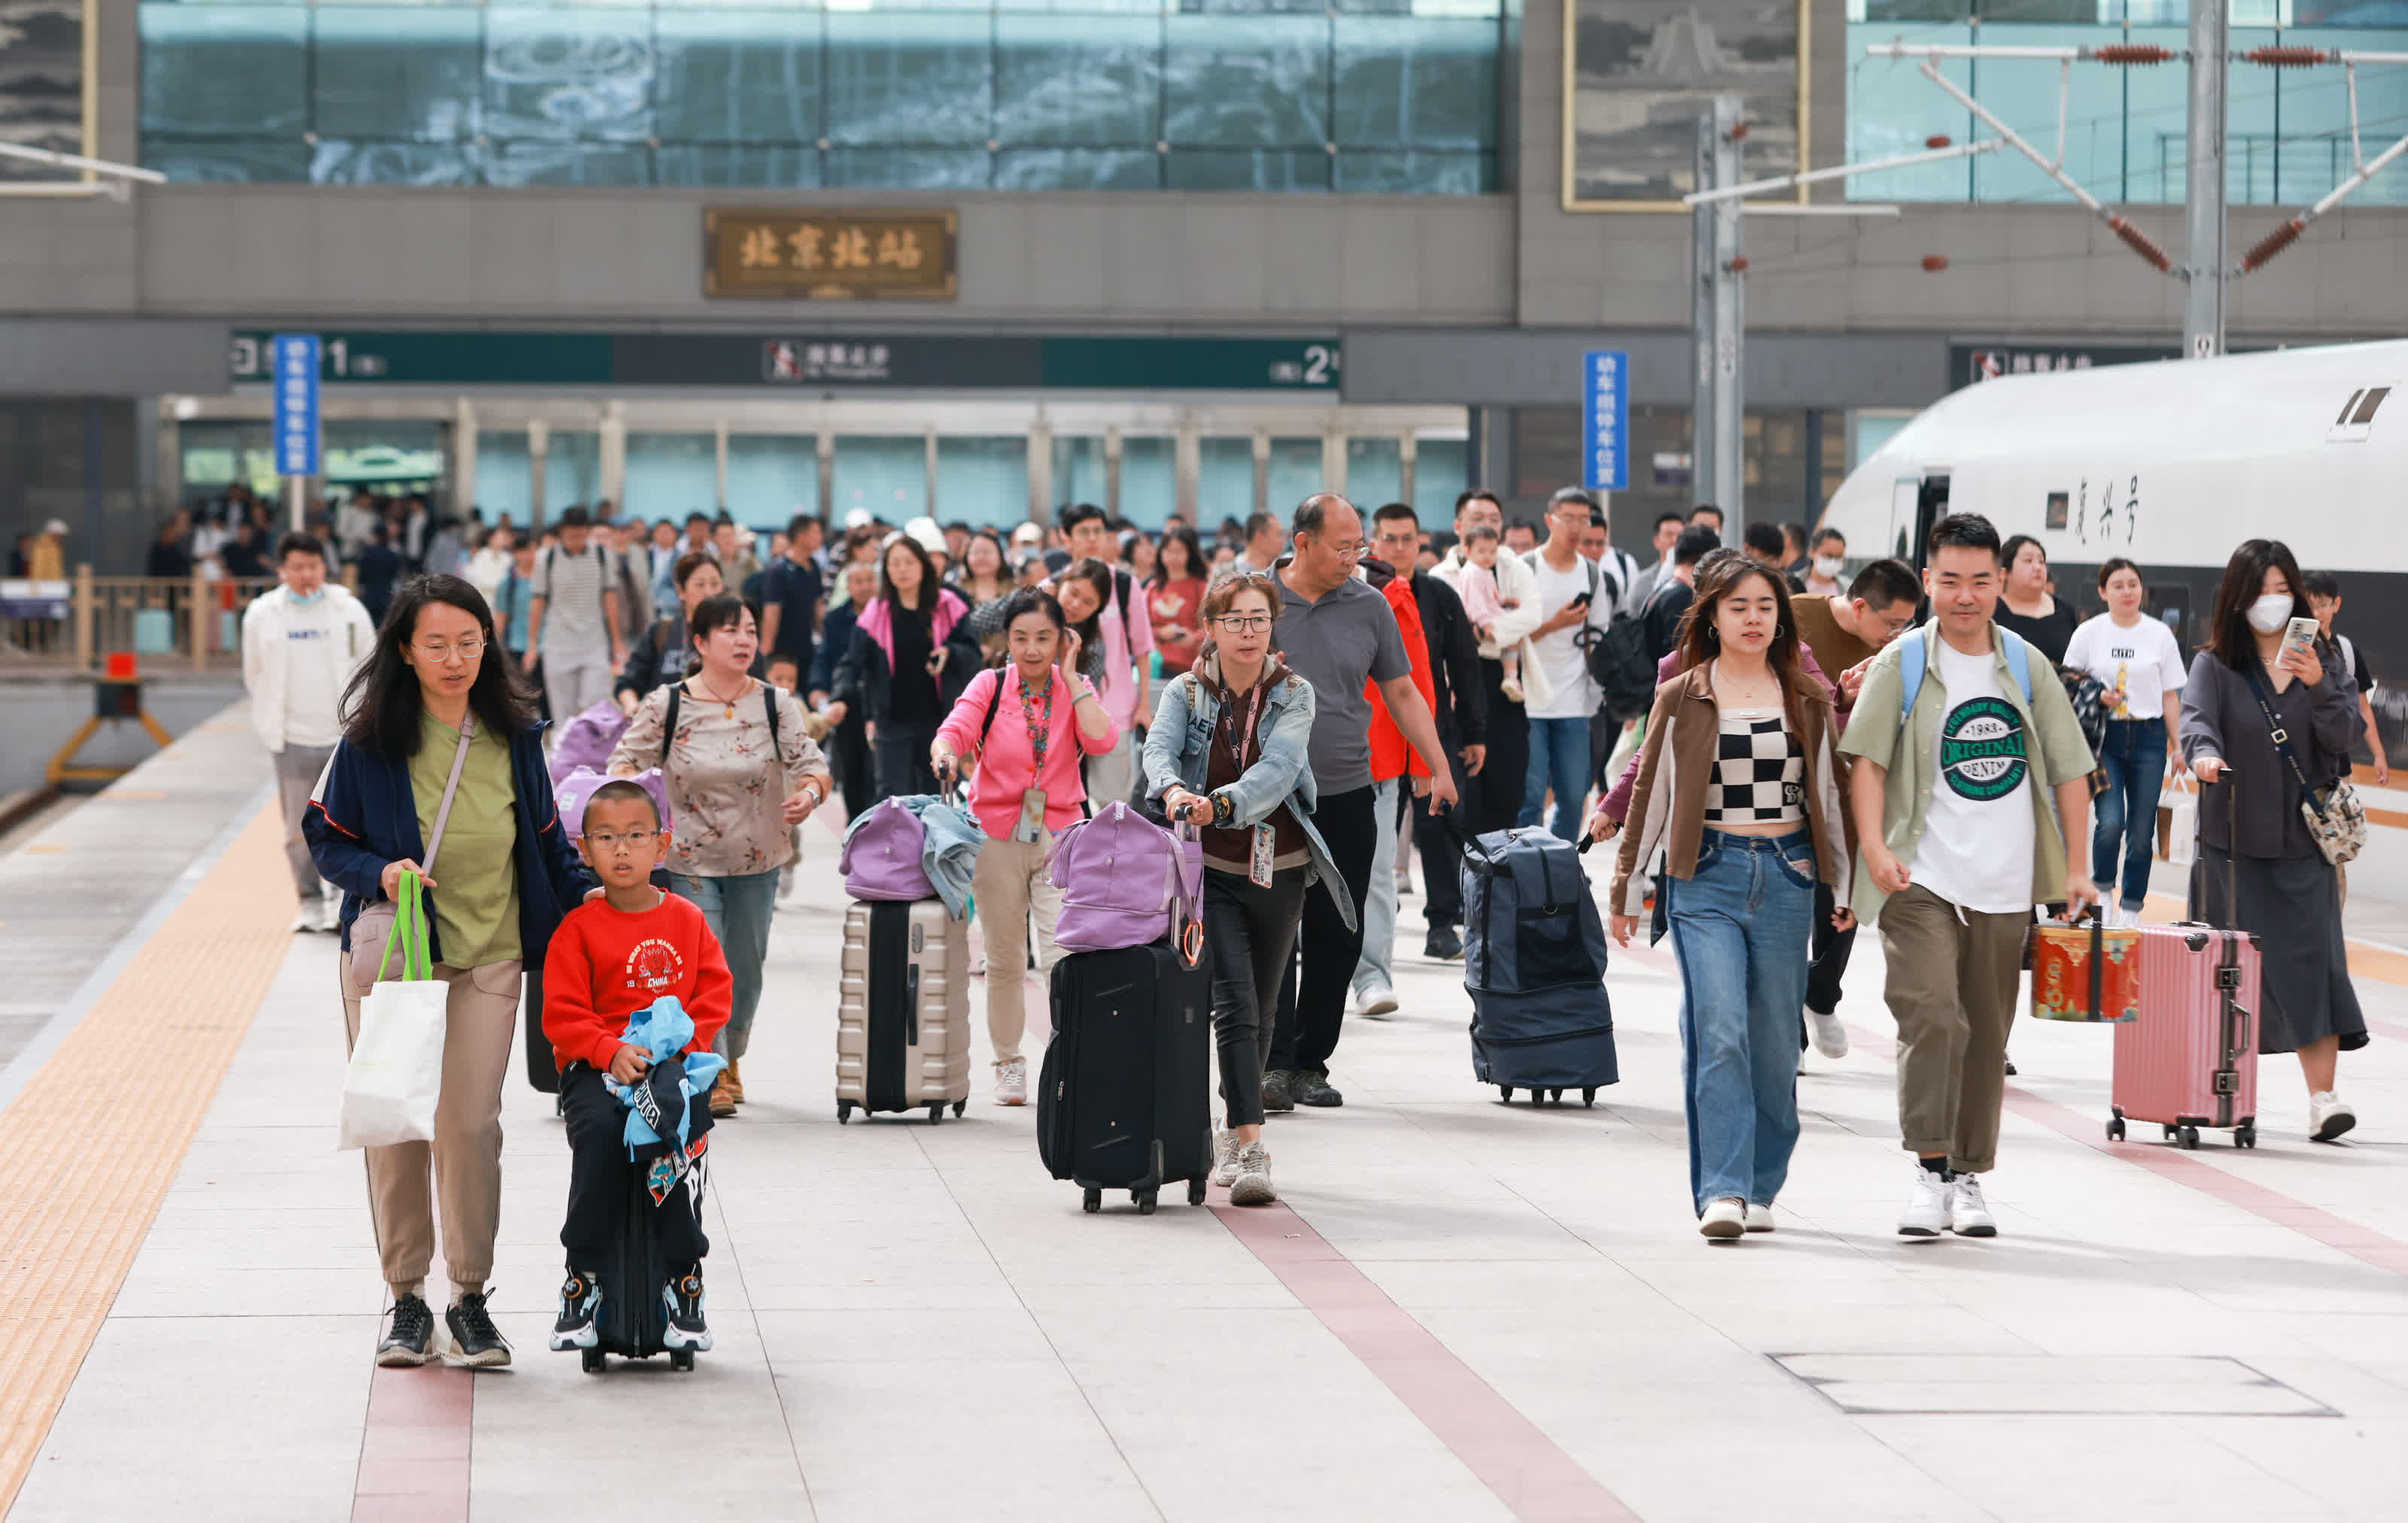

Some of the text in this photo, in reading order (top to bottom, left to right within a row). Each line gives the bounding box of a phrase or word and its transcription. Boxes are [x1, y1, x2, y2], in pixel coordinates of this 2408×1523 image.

[739, 224, 922, 268] 北京北站
[1305, 345, 1329, 383] 2
[2075, 475, 2139, 545] 复兴号
[1942, 733, 2026, 765] ORIGINAL
[640, 939, 655, 948] YOU
[647, 976, 668, 988] CHINA
